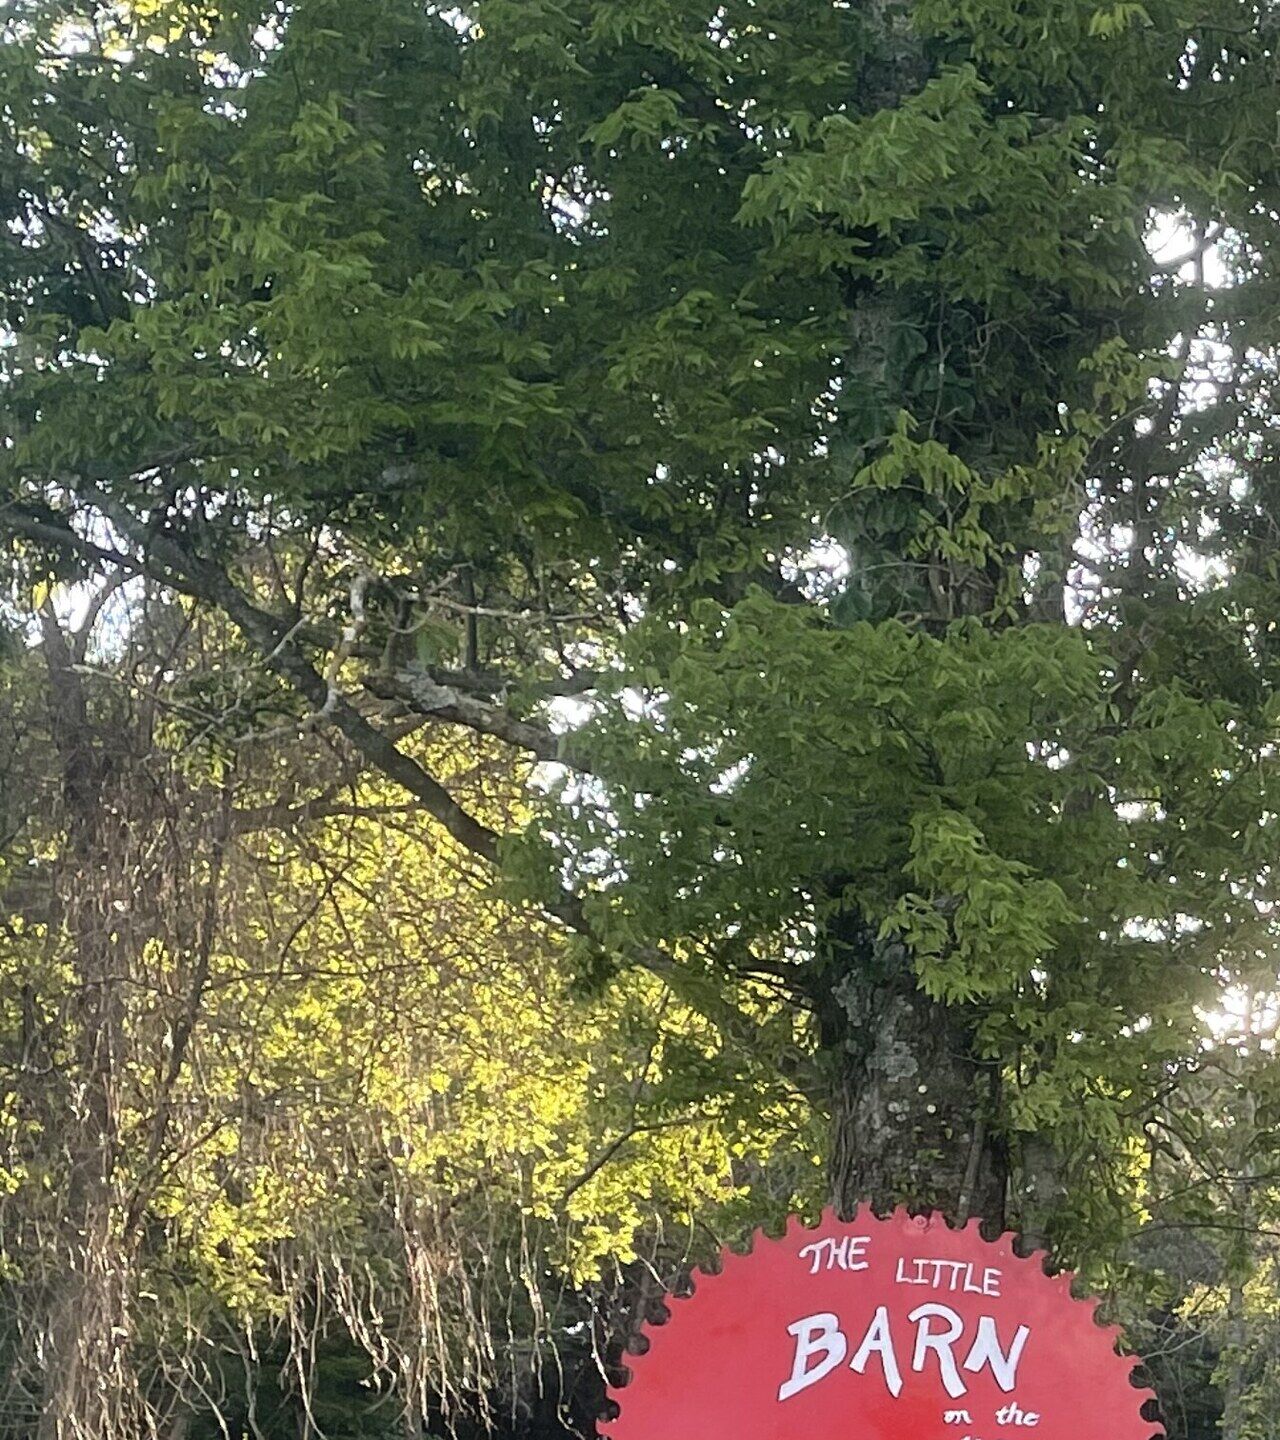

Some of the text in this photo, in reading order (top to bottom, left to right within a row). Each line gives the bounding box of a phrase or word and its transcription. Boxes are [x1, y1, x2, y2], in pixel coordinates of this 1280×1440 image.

[798, 1235, 1002, 1297] THE LITTLE
[778, 1303, 1030, 1401] BARN
[943, 1403, 1040, 1427] on the
